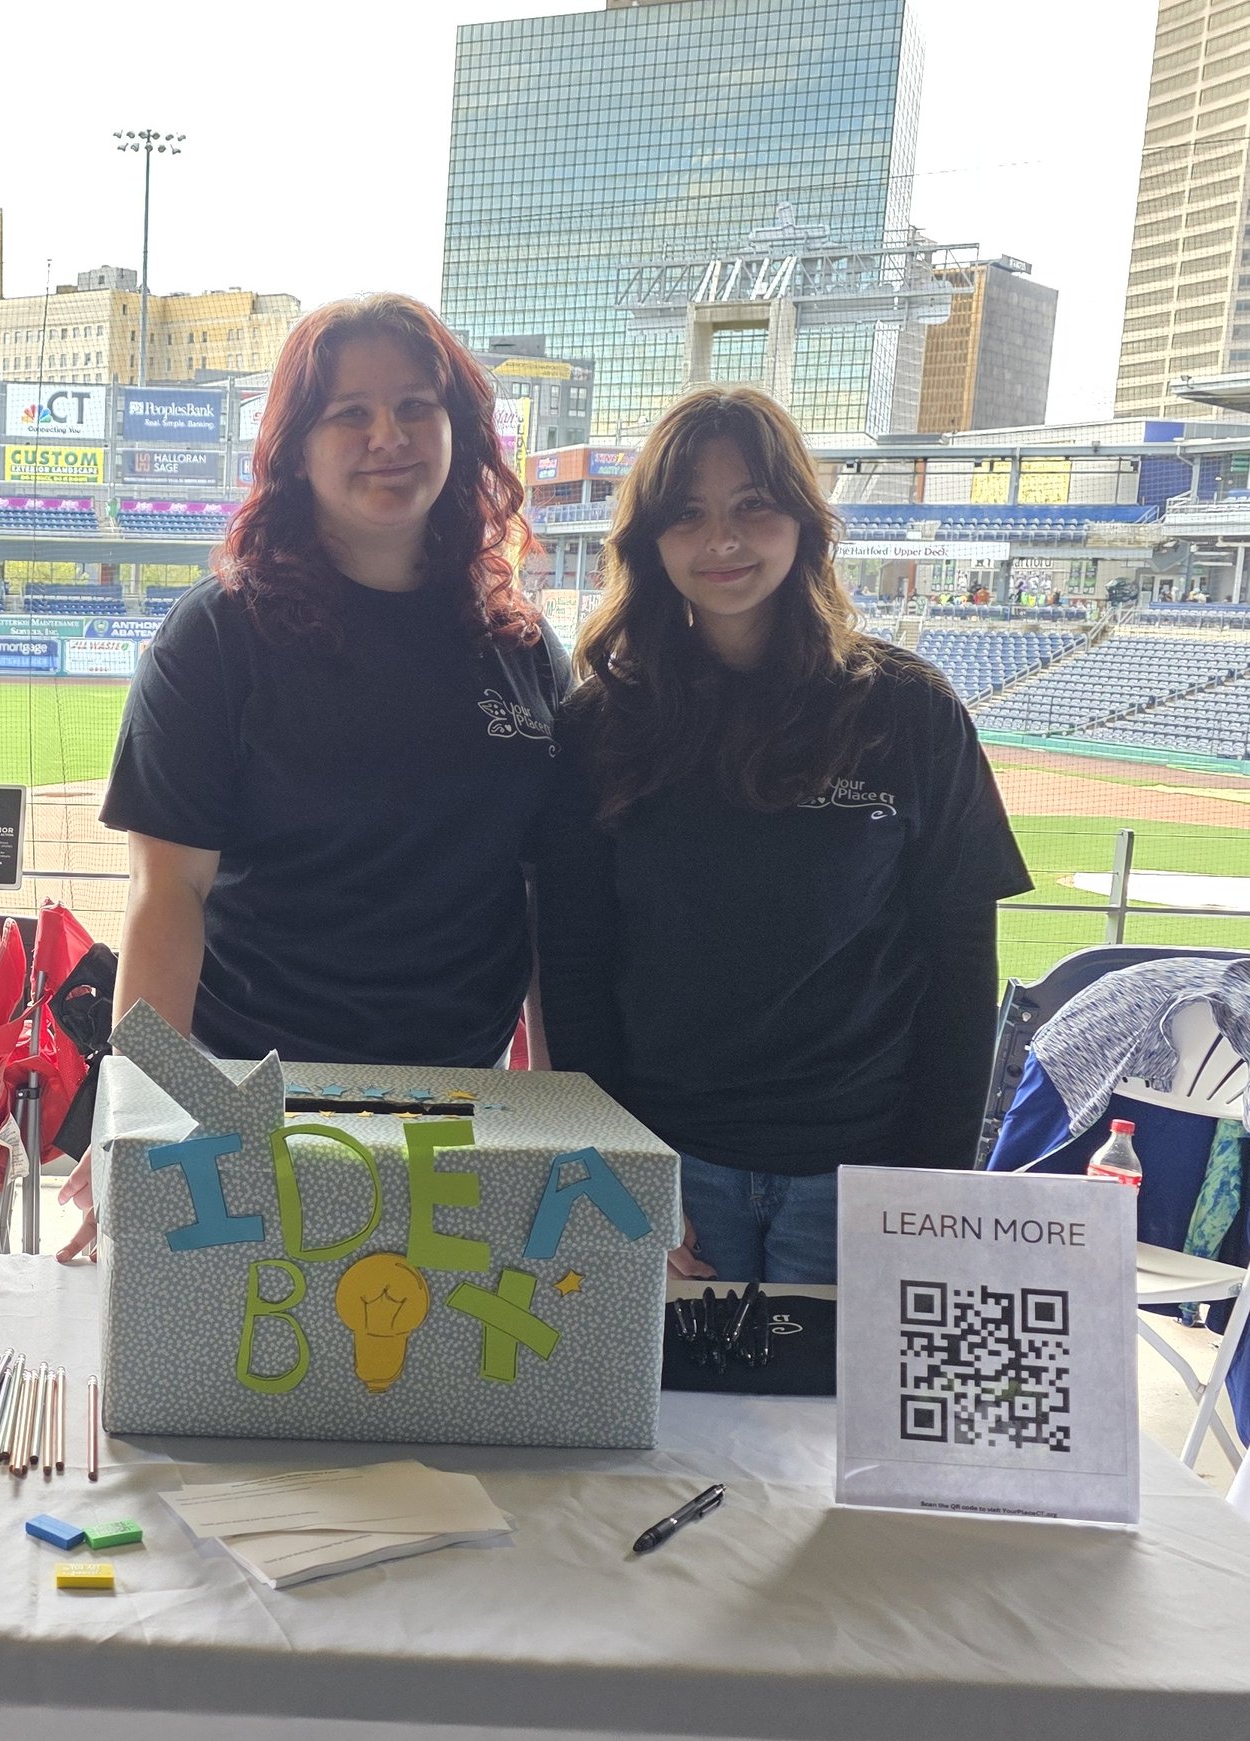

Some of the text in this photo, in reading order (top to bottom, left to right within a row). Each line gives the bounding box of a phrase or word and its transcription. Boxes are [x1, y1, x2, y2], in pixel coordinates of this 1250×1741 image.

[47, 390, 91, 425] CT
[145, 401, 215, 418] PeoplesBank
[27, 425, 81, 434] Connecting You
[11, 449, 98, 466] CUSTOM
[153, 453, 207, 464] HALLORAN
[11, 465, 97, 474] EXTERIOR LANDSCAPE
[153, 463, 179, 473] SAGE
[851, 546, 889, 556] Hartford
[894, 546, 921, 556] Upper
[924, 546, 948, 556] Deck
[838, 788, 877, 801] Place
[150, 1119, 653, 1273] IDEA
[881, 1211, 1086, 1247] LEARN MORE
